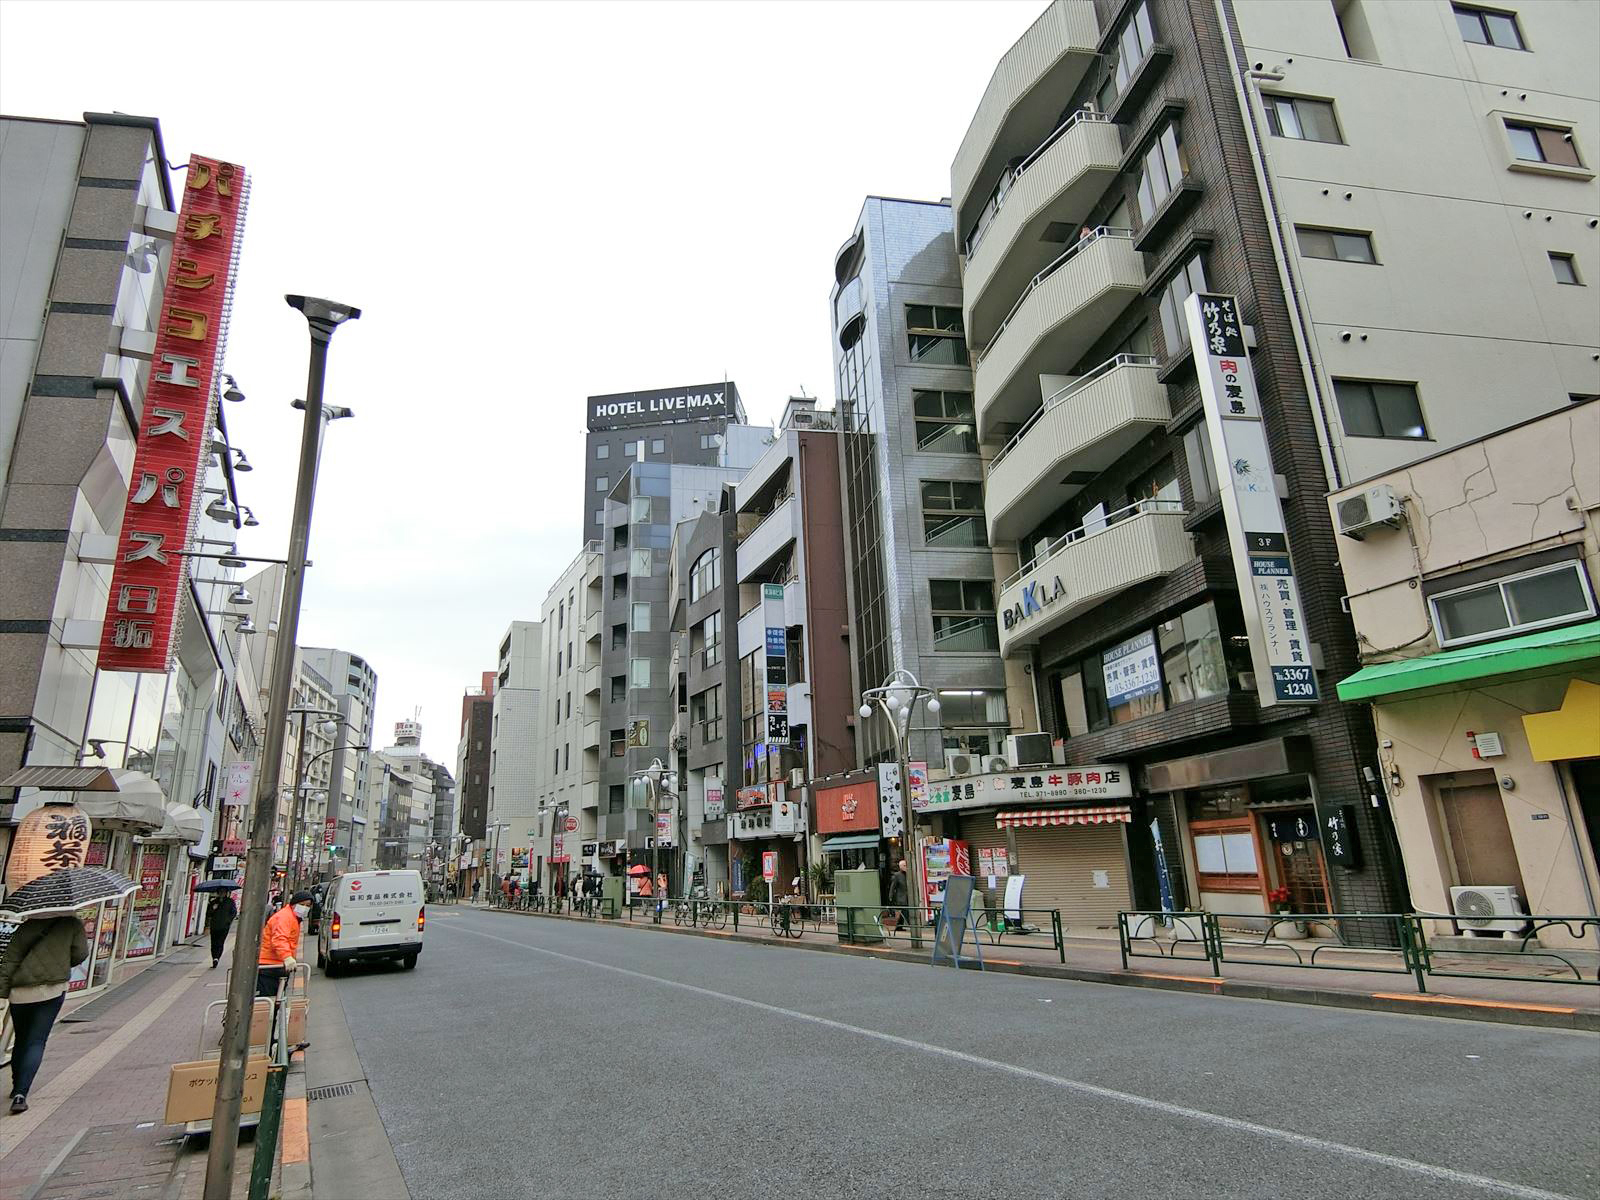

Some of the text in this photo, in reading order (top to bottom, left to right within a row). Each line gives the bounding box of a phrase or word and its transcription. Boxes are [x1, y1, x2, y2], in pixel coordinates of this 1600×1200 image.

[596, 401, 646, 417] HOTEL
[1258, 537, 1272, 547] 3F
[1002, 575, 1066, 631] BAKLA
[1103, 647, 1123, 664] HOUSE
[1122, 634, 1153, 656] PLANNER
